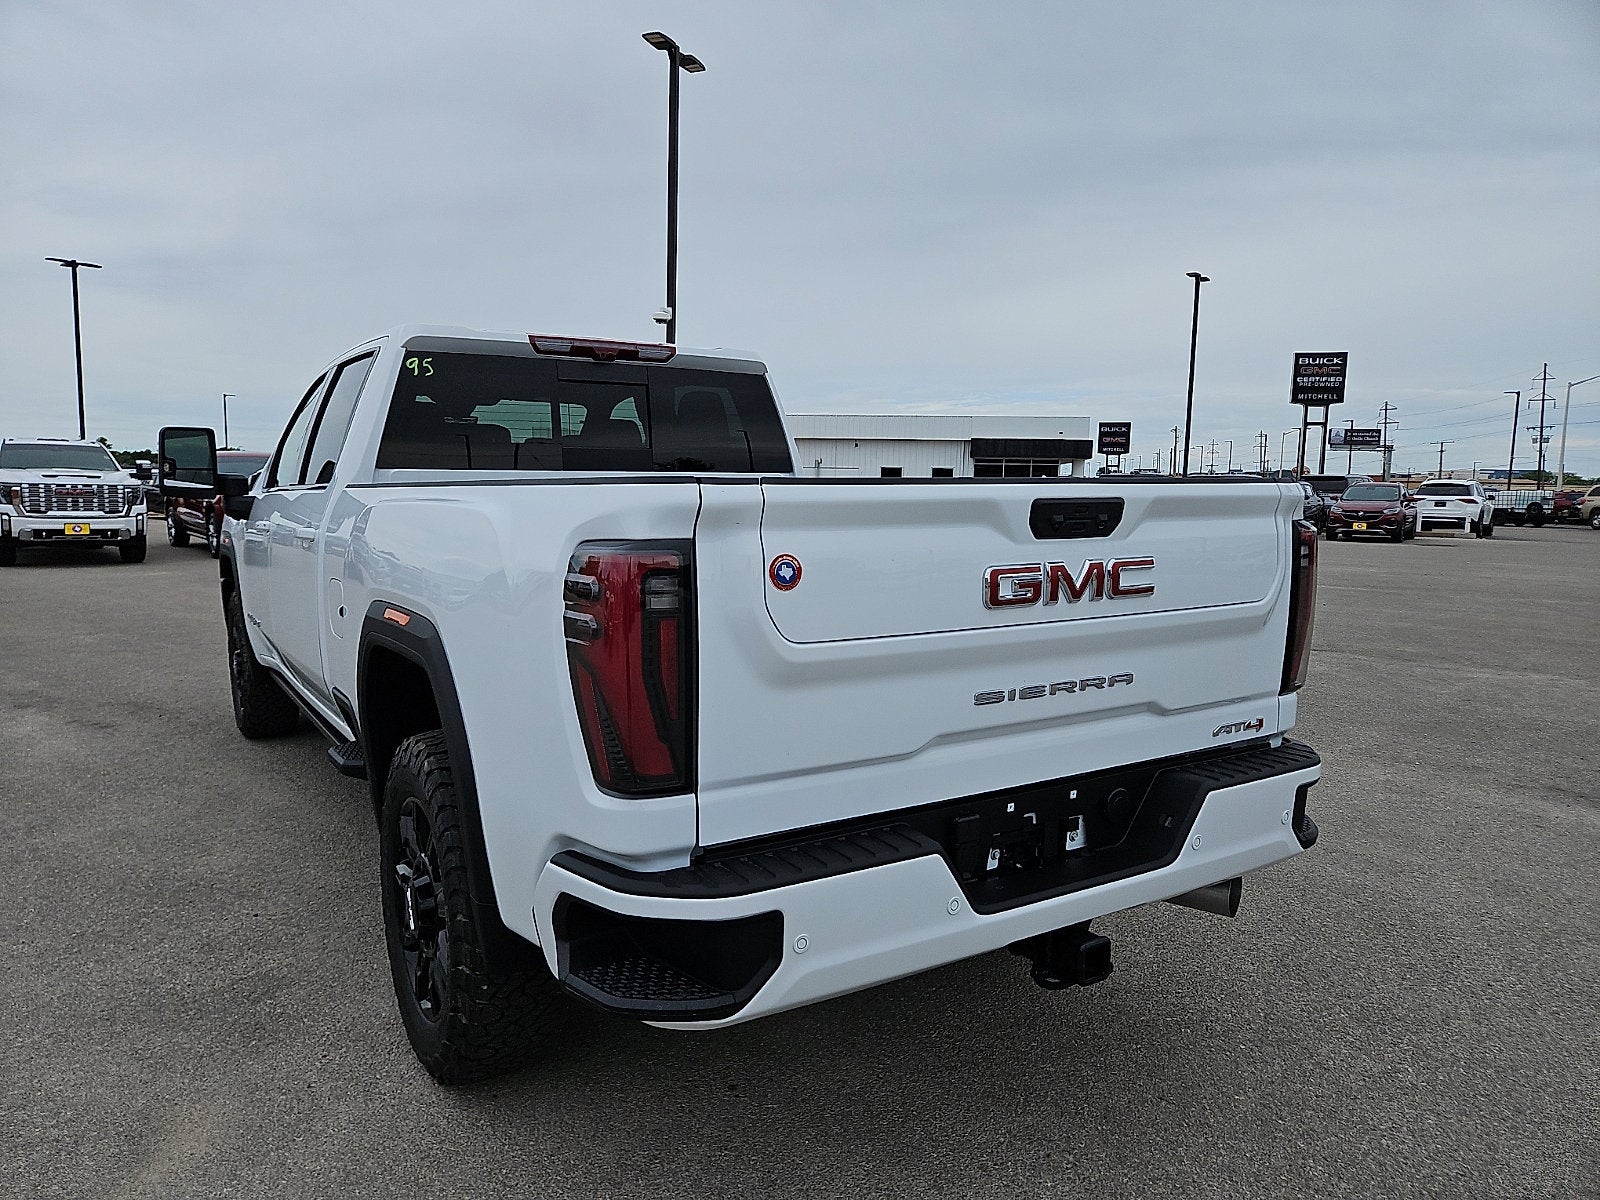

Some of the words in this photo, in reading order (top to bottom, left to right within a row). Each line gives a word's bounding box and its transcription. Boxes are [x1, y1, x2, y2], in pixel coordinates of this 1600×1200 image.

[405, 357, 434, 377] 95
[1300, 366, 1341, 374] GMC
[982, 556, 1155, 610] GMC
[973, 671, 1135, 706] SIERRA
[1212, 717, 1264, 737] AT4
